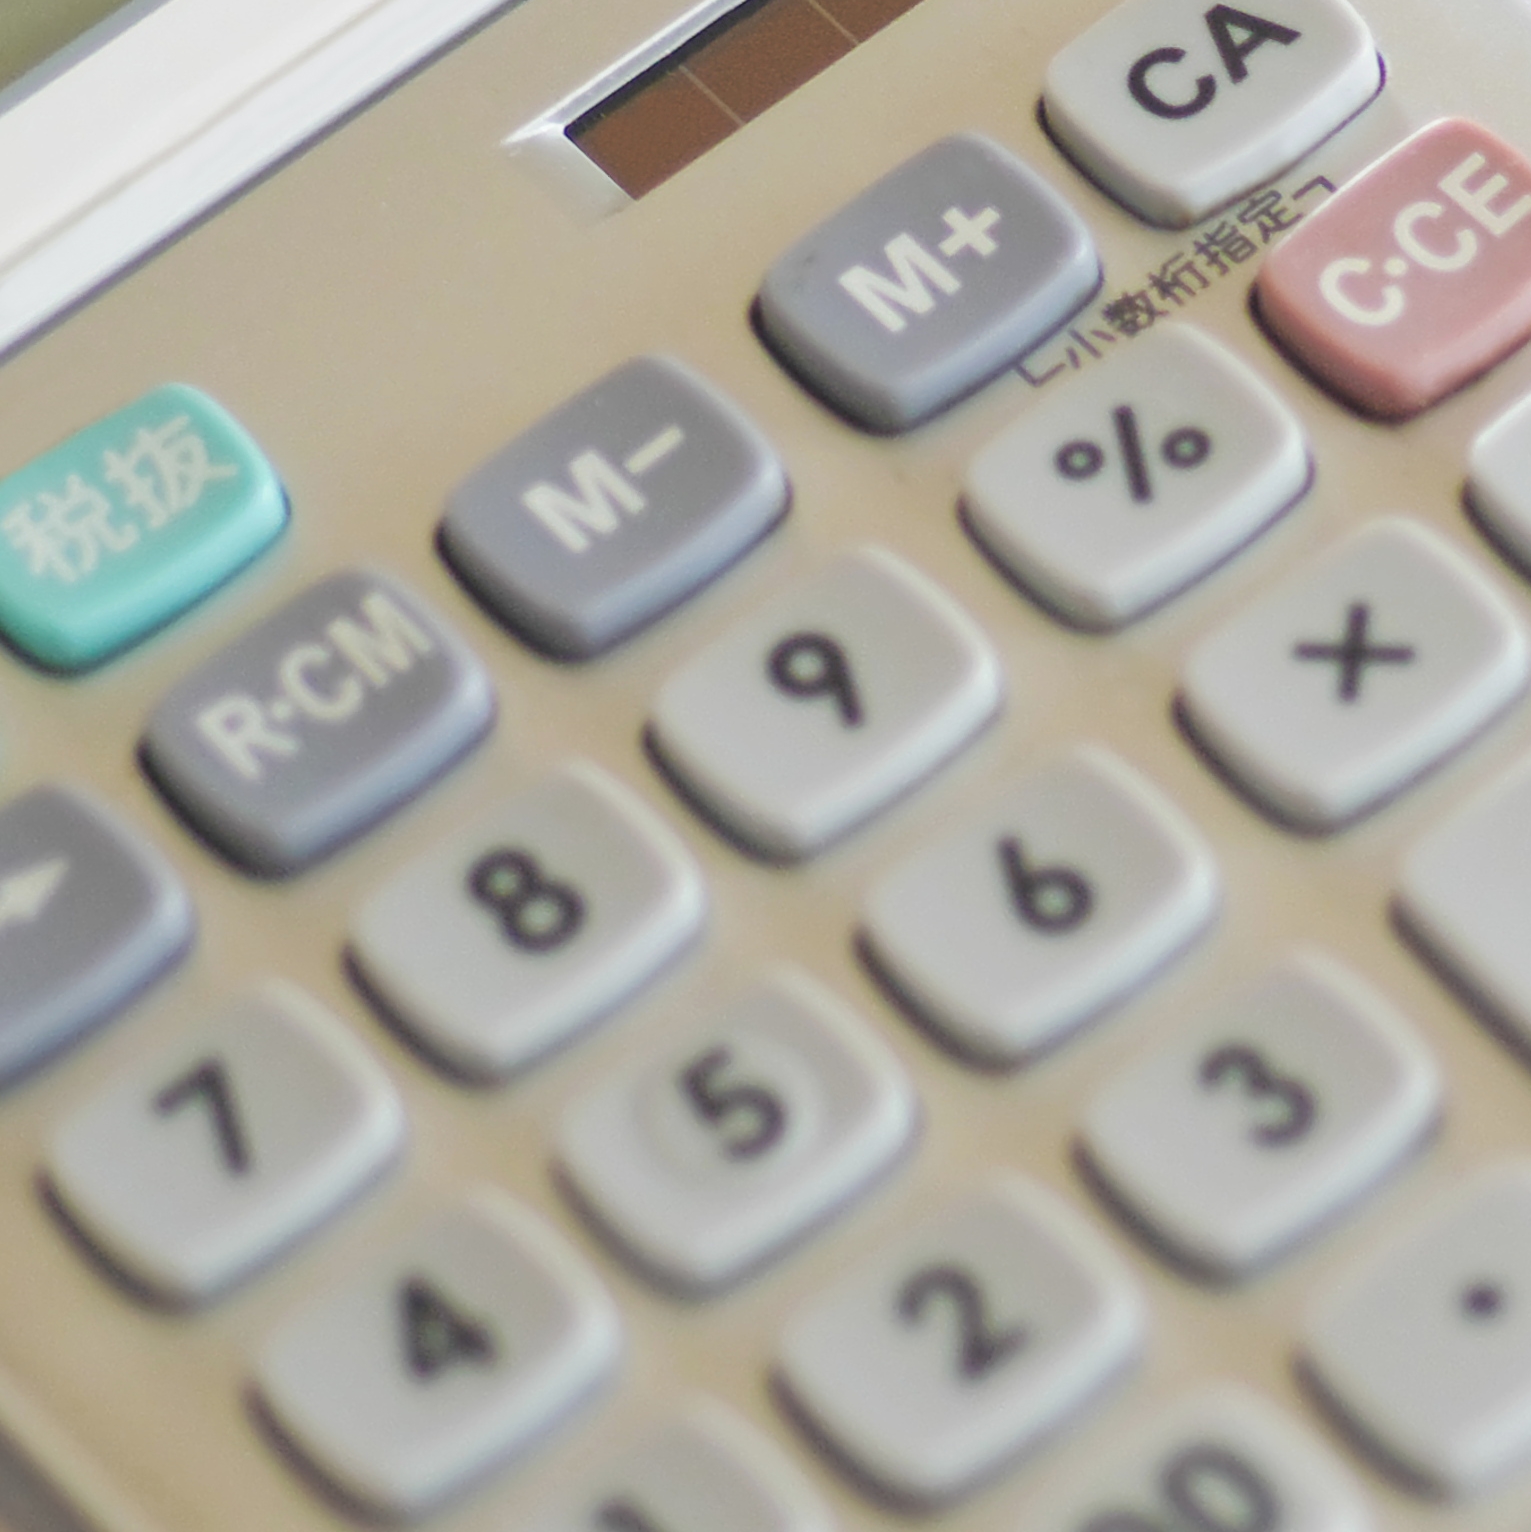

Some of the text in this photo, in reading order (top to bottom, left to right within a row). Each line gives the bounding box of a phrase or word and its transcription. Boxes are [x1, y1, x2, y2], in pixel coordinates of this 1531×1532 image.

[1127, 3, 1301, 119] CA
[838, 205, 1001, 334] M+
[3, 415, 239, 586] 税抜
[1053, 406, 1211, 504] %
[765, 632, 864, 728] 9
[468, 848, 586, 953] 8
[998, 835, 1094, 936] 6
[155, 1054, 250, 1176] 7
[680, 1044, 785, 1160] 5
[1199, 1044, 1316, 1150] 3
[400, 1272, 499, 1382] 4
[898, 1267, 1026, 1380] 2
[1075, 1440, 1280, 1532] 0
